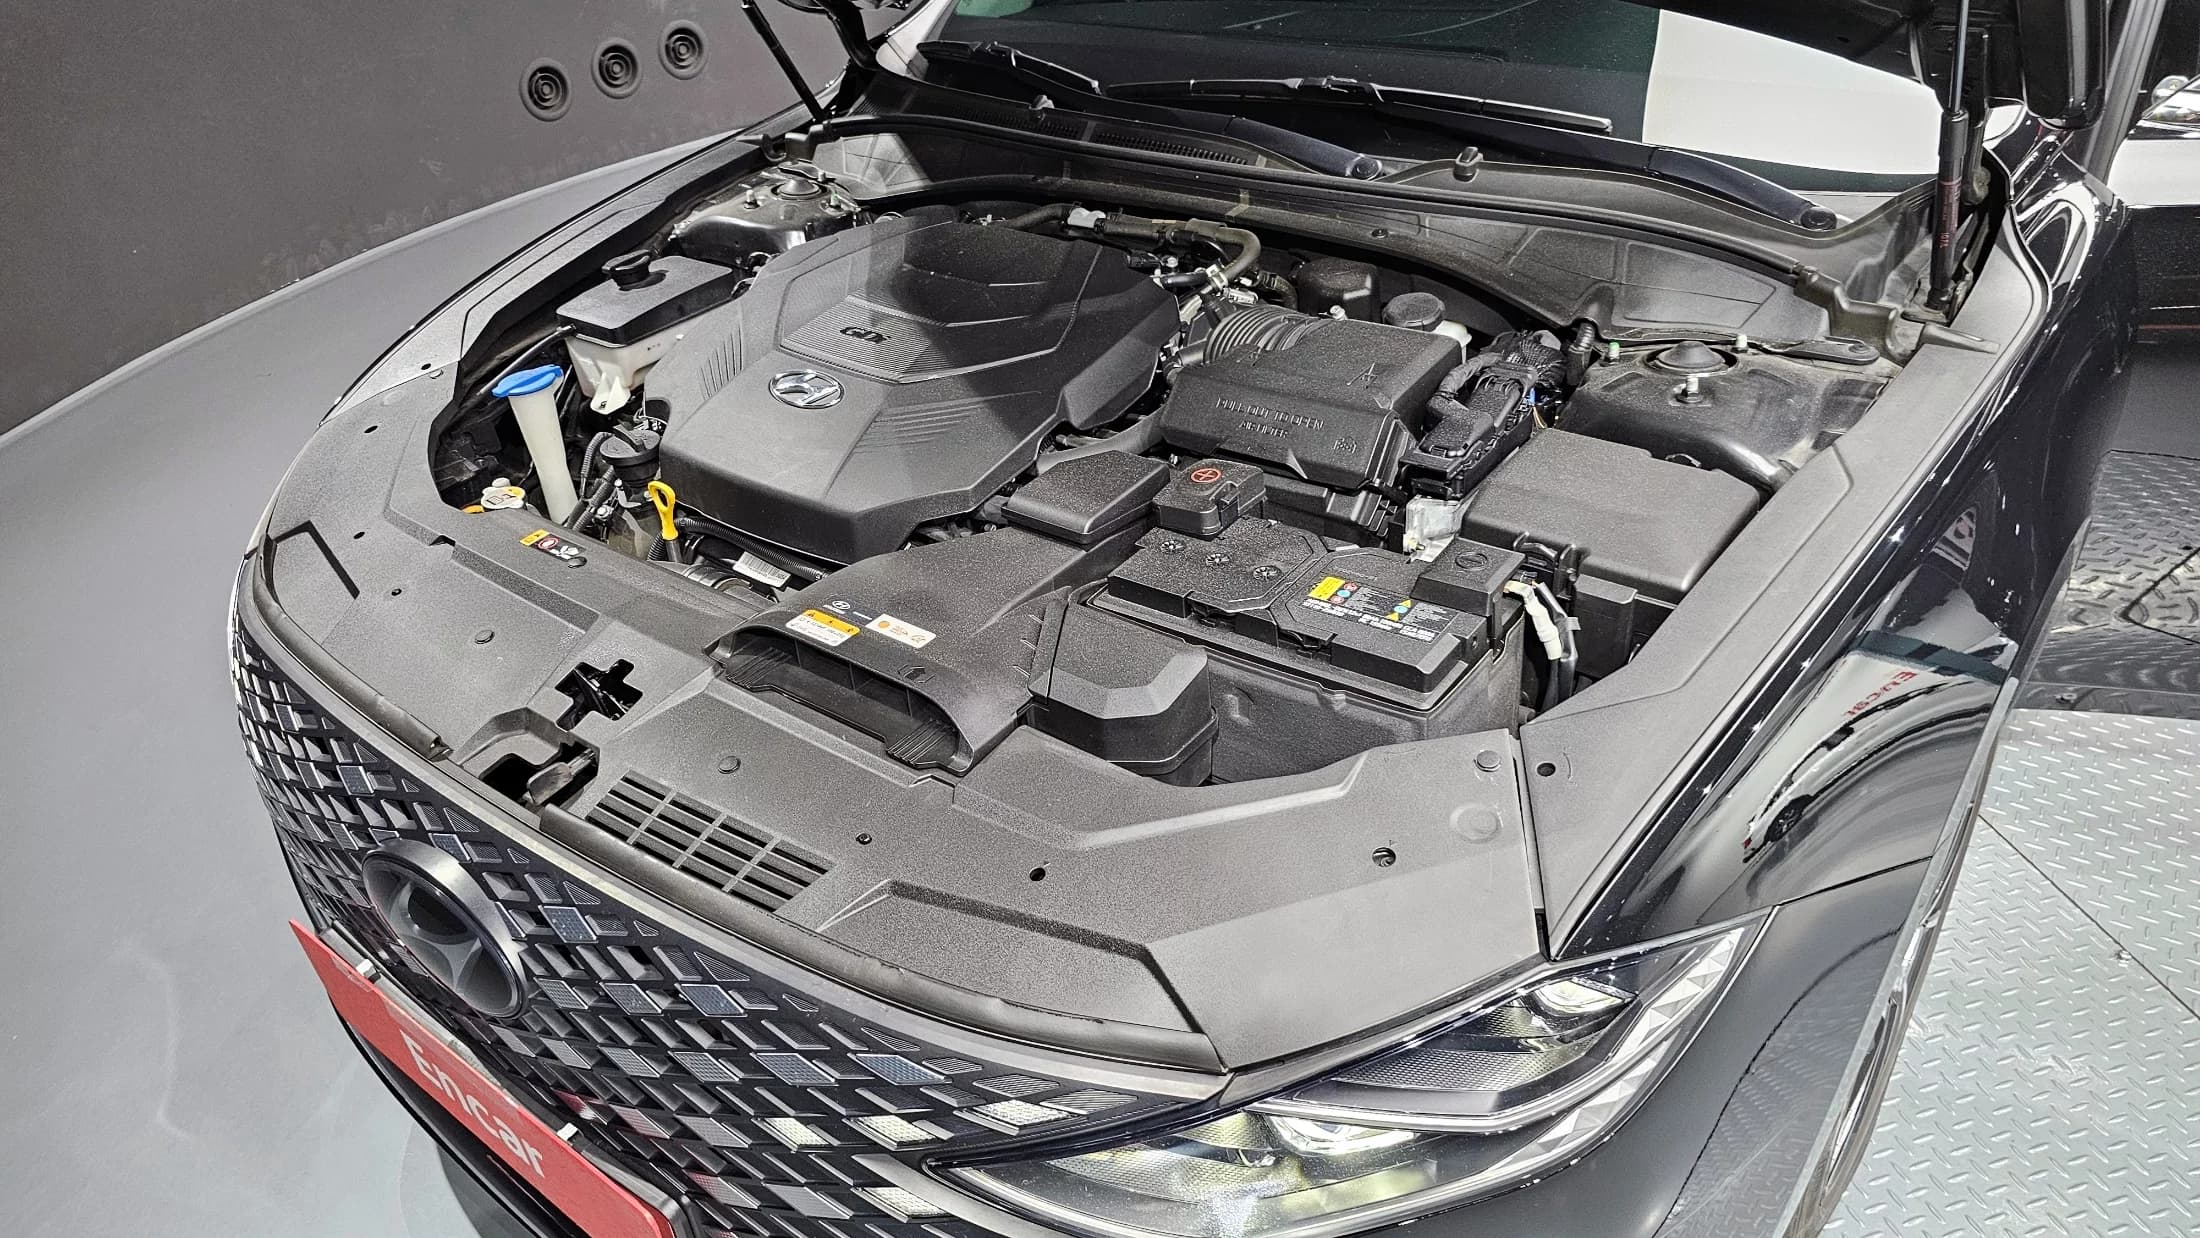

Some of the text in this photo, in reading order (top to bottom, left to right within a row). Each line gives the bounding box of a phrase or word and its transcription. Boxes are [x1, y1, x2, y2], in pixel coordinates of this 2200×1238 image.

[1216, 397, 1324, 431] PULL OUT TO OPEN
[400, 1029, 545, 1178] Encar
